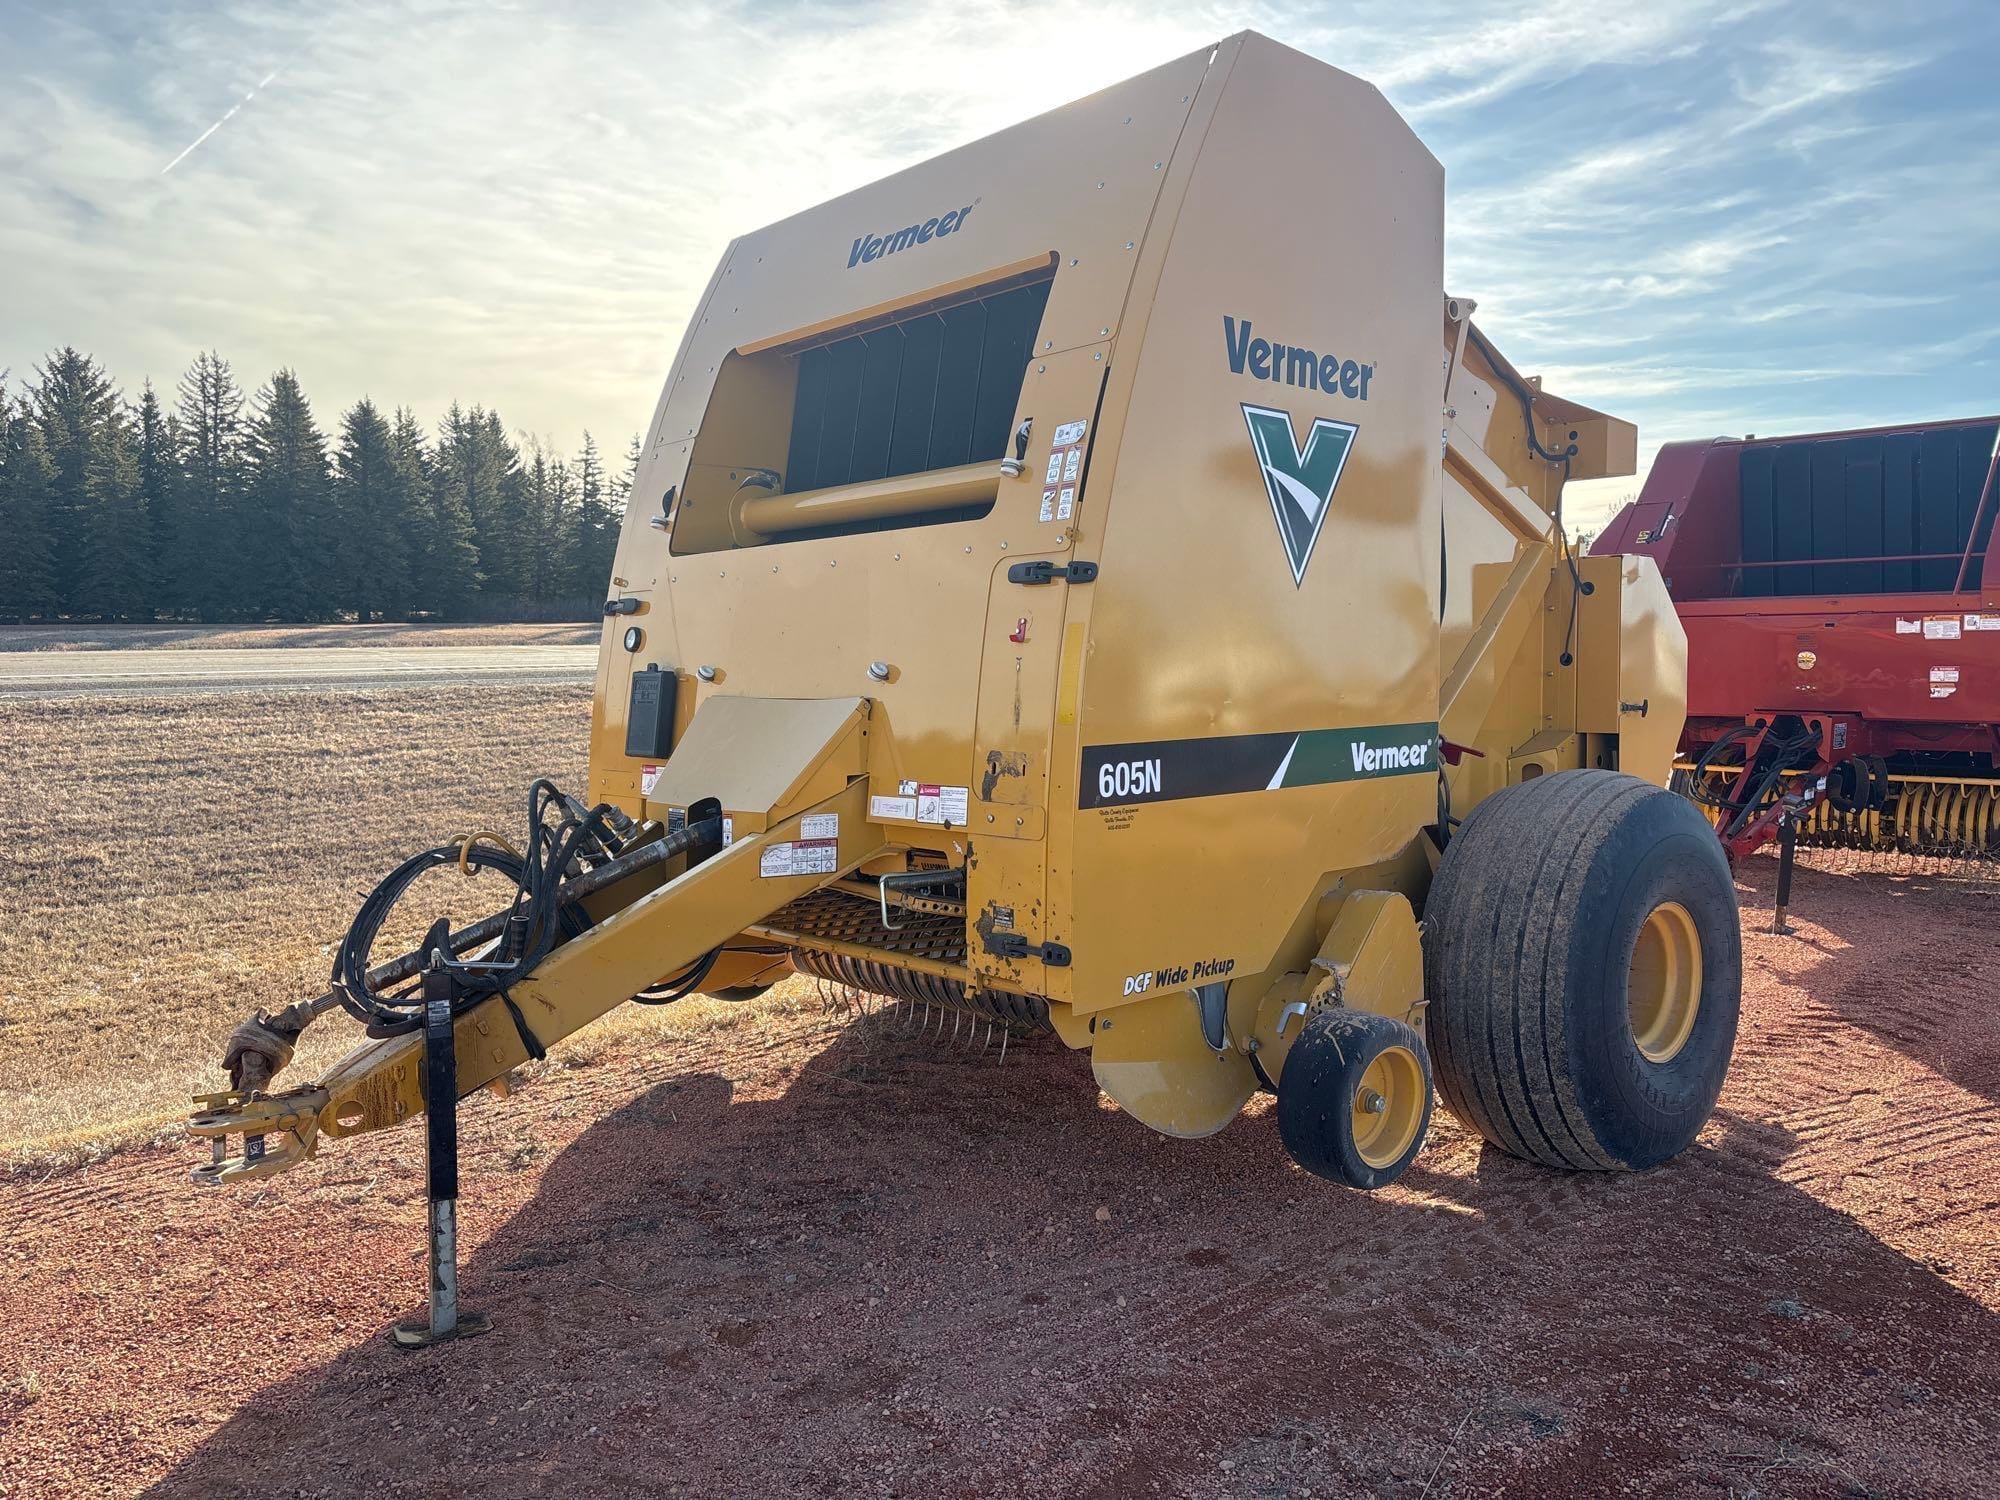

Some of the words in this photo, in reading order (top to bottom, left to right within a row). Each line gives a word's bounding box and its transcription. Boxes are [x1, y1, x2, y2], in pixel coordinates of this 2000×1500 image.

[847, 204, 974, 269] Vermeer
[1223, 315, 1374, 401] Vermeer
[1350, 741, 1428, 772] Vermeer
[1099, 758, 1161, 798] 605N
[803, 840, 832, 848] WARNING
[1123, 971, 1153, 996] DCF
[1155, 966, 1188, 988] Wide
[1192, 958, 1235, 979] Pickup
